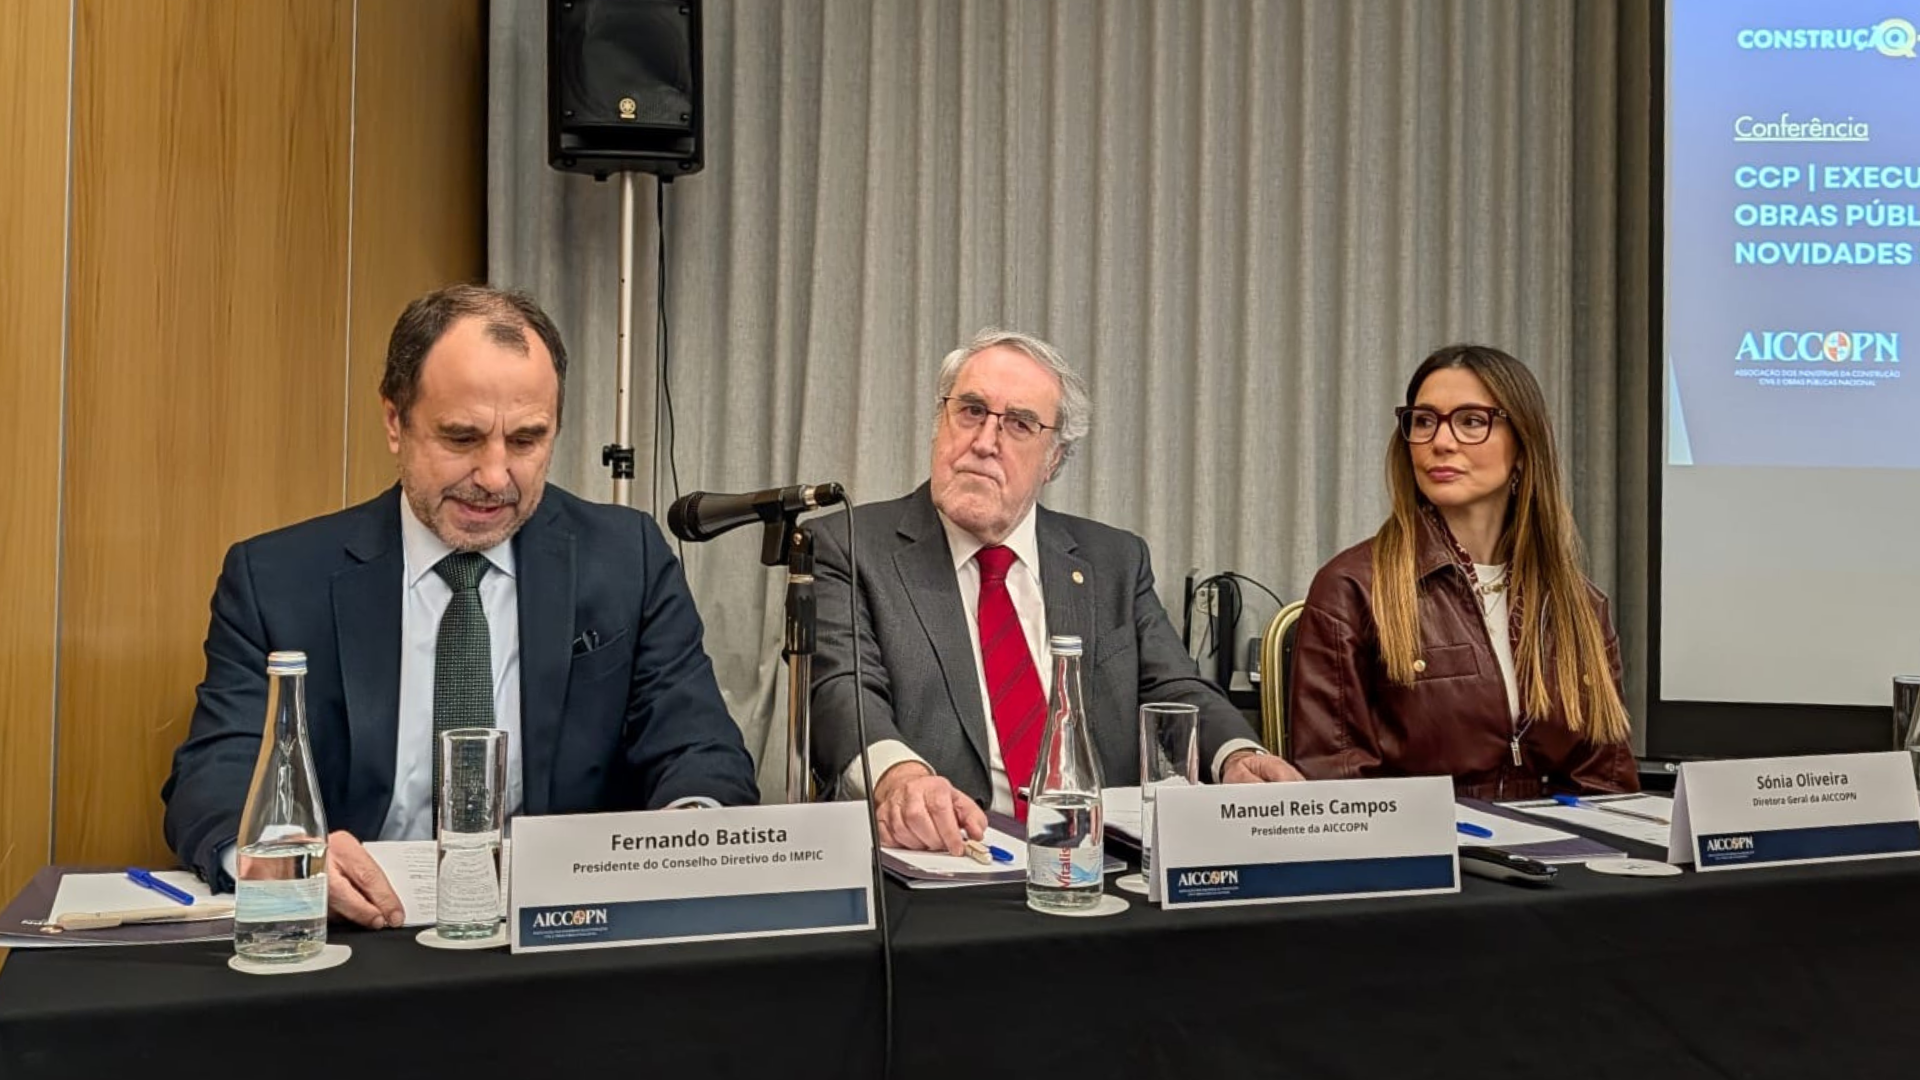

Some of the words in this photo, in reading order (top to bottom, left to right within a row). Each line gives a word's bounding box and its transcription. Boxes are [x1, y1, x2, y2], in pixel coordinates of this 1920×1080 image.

[1734, 113, 1870, 141] Conferência
[1735, 166, 1800, 188] CCP
[1824, 166, 1920, 188] EXECU
[1735, 204, 1838, 226] OBRAS
[1846, 199, 1920, 226] PÚBL
[1735, 242, 1912, 265] NOVIDADES
[1735, 331, 1900, 362] AICCOPN
[1756, 774, 1793, 790] Sónia
[1796, 772, 1848, 788] Oliveira
[1220, 801, 1285, 819] Manuel
[1290, 800, 1324, 816] Reis
[1328, 799, 1398, 818] Campos
[1752, 797, 1786, 807] Diretora
[1787, 794, 1808, 805] Geral
[1810, 794, 1820, 804] da
[1821, 791, 1857, 803] AICCOPN
[611, 830, 710, 851] Fernando
[716, 827, 788, 846] Batista
[1250, 825, 1306, 836] Presidente
[1307, 823, 1321, 834] da
[1322, 822, 1369, 833] AICCOPN
[572, 861, 640, 874] Presidente
[642, 859, 659, 870] do
[661, 855, 718, 870] Conselho
[720, 853, 769, 866] Diretivo
[771, 852, 787, 863] do
[789, 850, 824, 862] IMPIC
[1058, 846, 1071, 890] Vitalis
[1178, 870, 1239, 886] AICCOPN
[532, 908, 608, 928] AICCOPN
